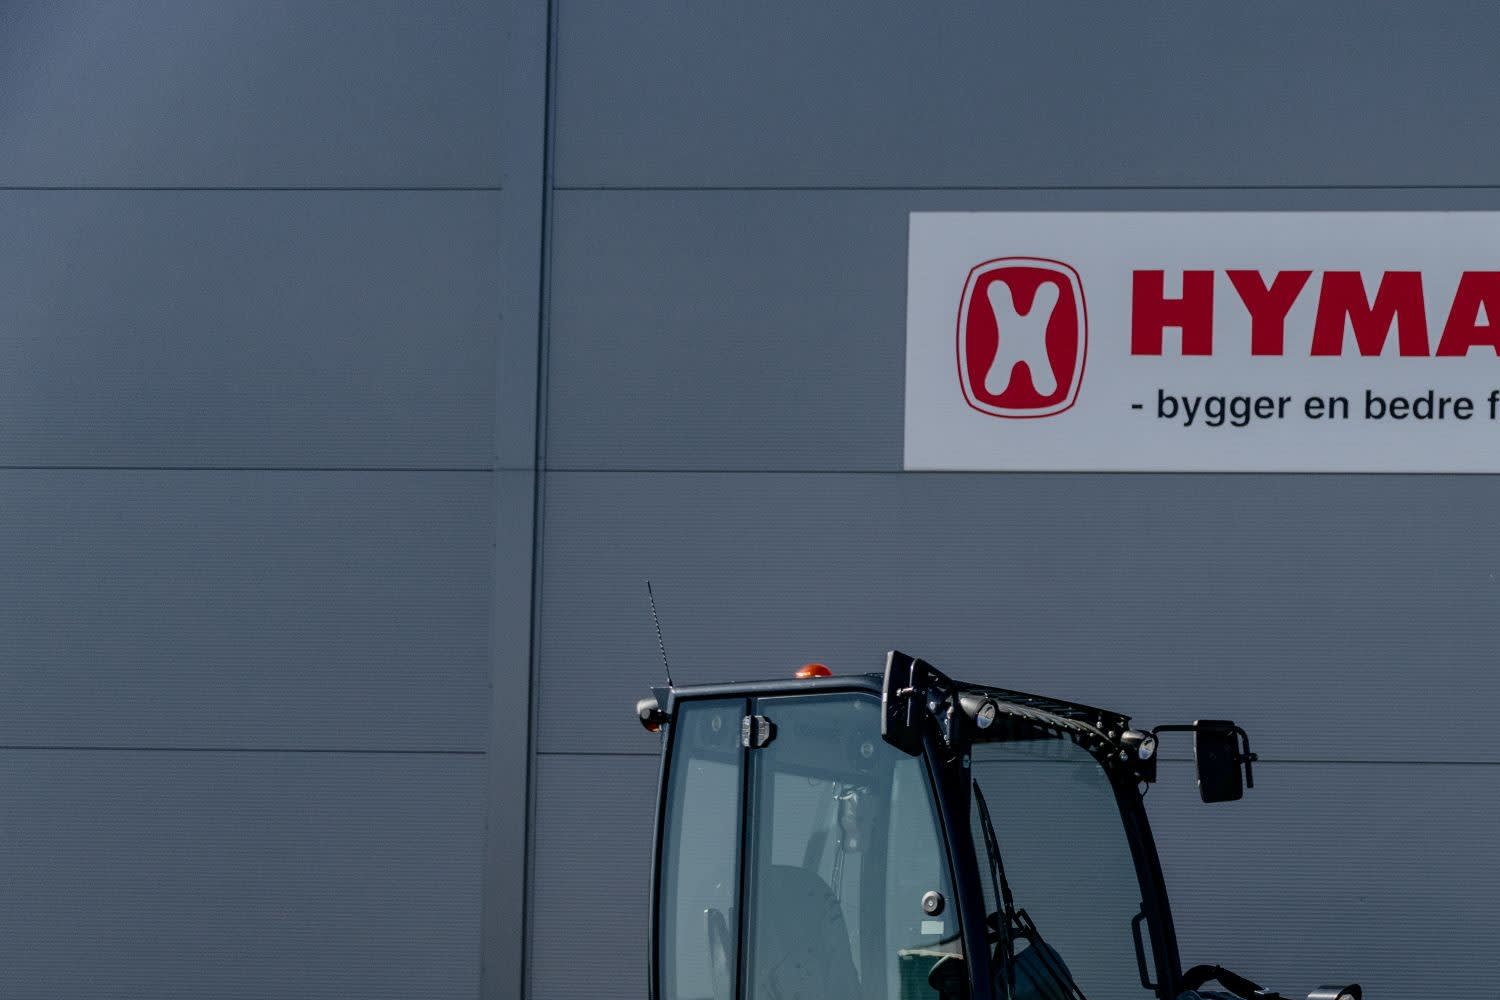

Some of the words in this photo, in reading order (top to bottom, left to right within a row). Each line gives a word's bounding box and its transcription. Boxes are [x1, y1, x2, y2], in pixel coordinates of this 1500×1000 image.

[1156, 388, 1292, 428] bygger
[1303, 393, 1350, 421] en
[1363, 390, 1475, 421] bedre
